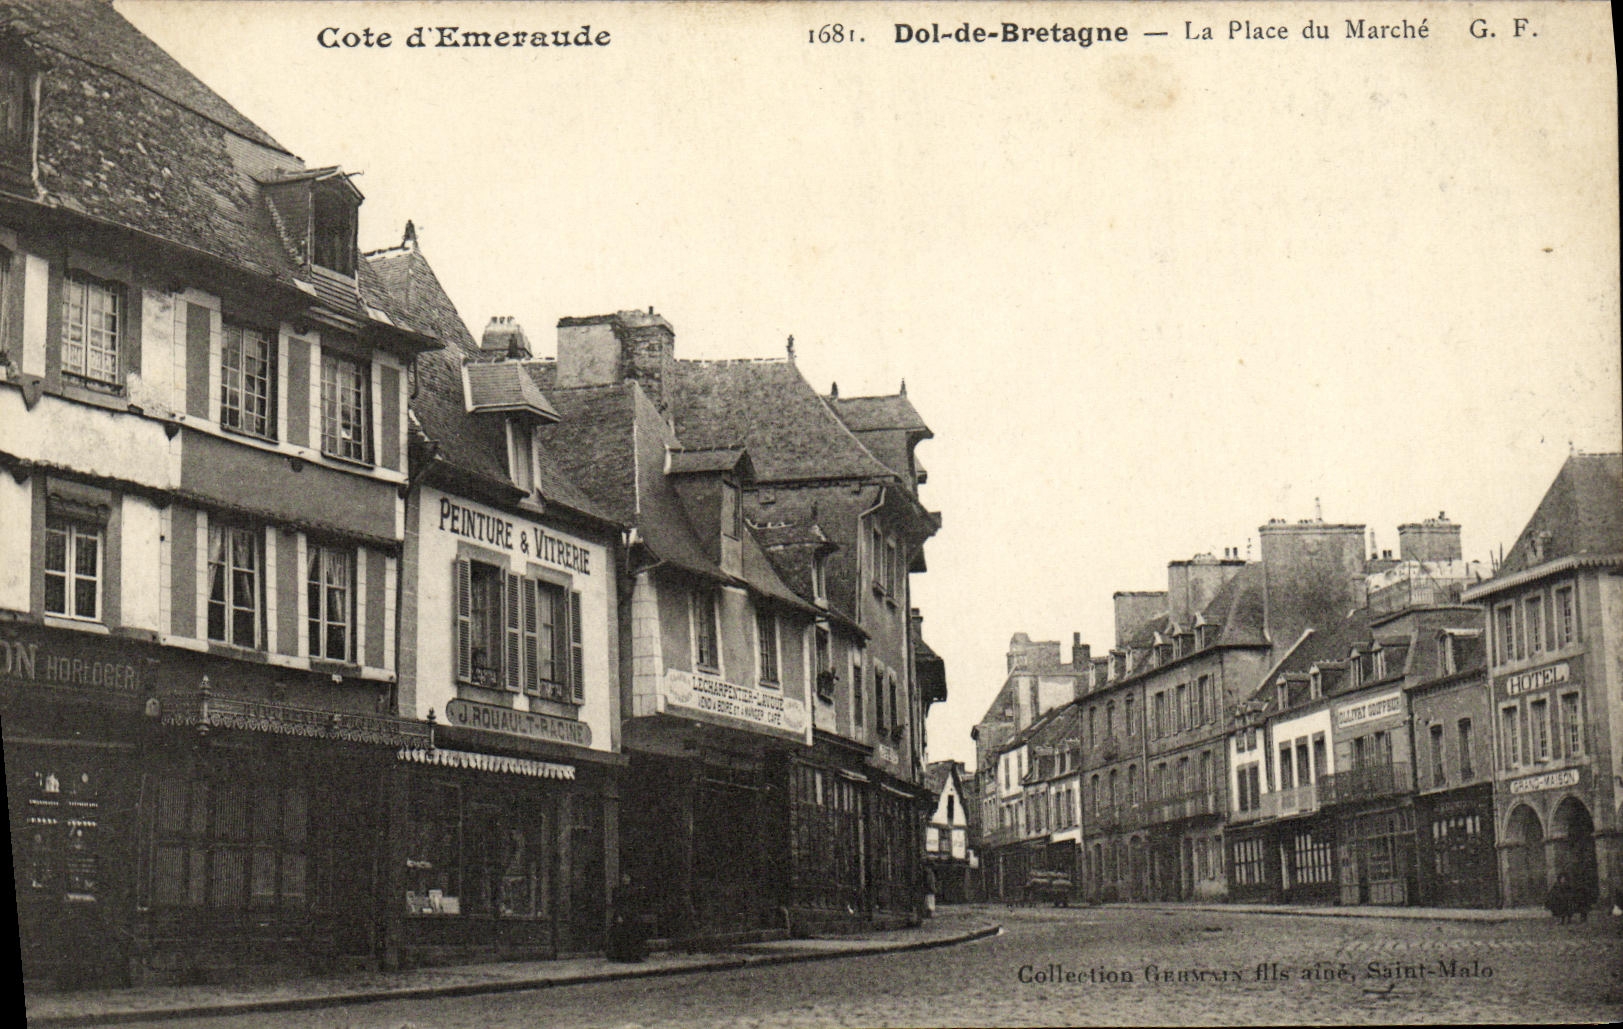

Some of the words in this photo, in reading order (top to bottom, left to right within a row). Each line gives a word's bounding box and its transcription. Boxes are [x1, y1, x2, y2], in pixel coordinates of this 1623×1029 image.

[438, 496, 514, 550] PEINTURE
[519, 530, 529, 556] &
[533, 527, 591, 576] VITRERIE
[1510, 667, 1566, 694] HOTEL
